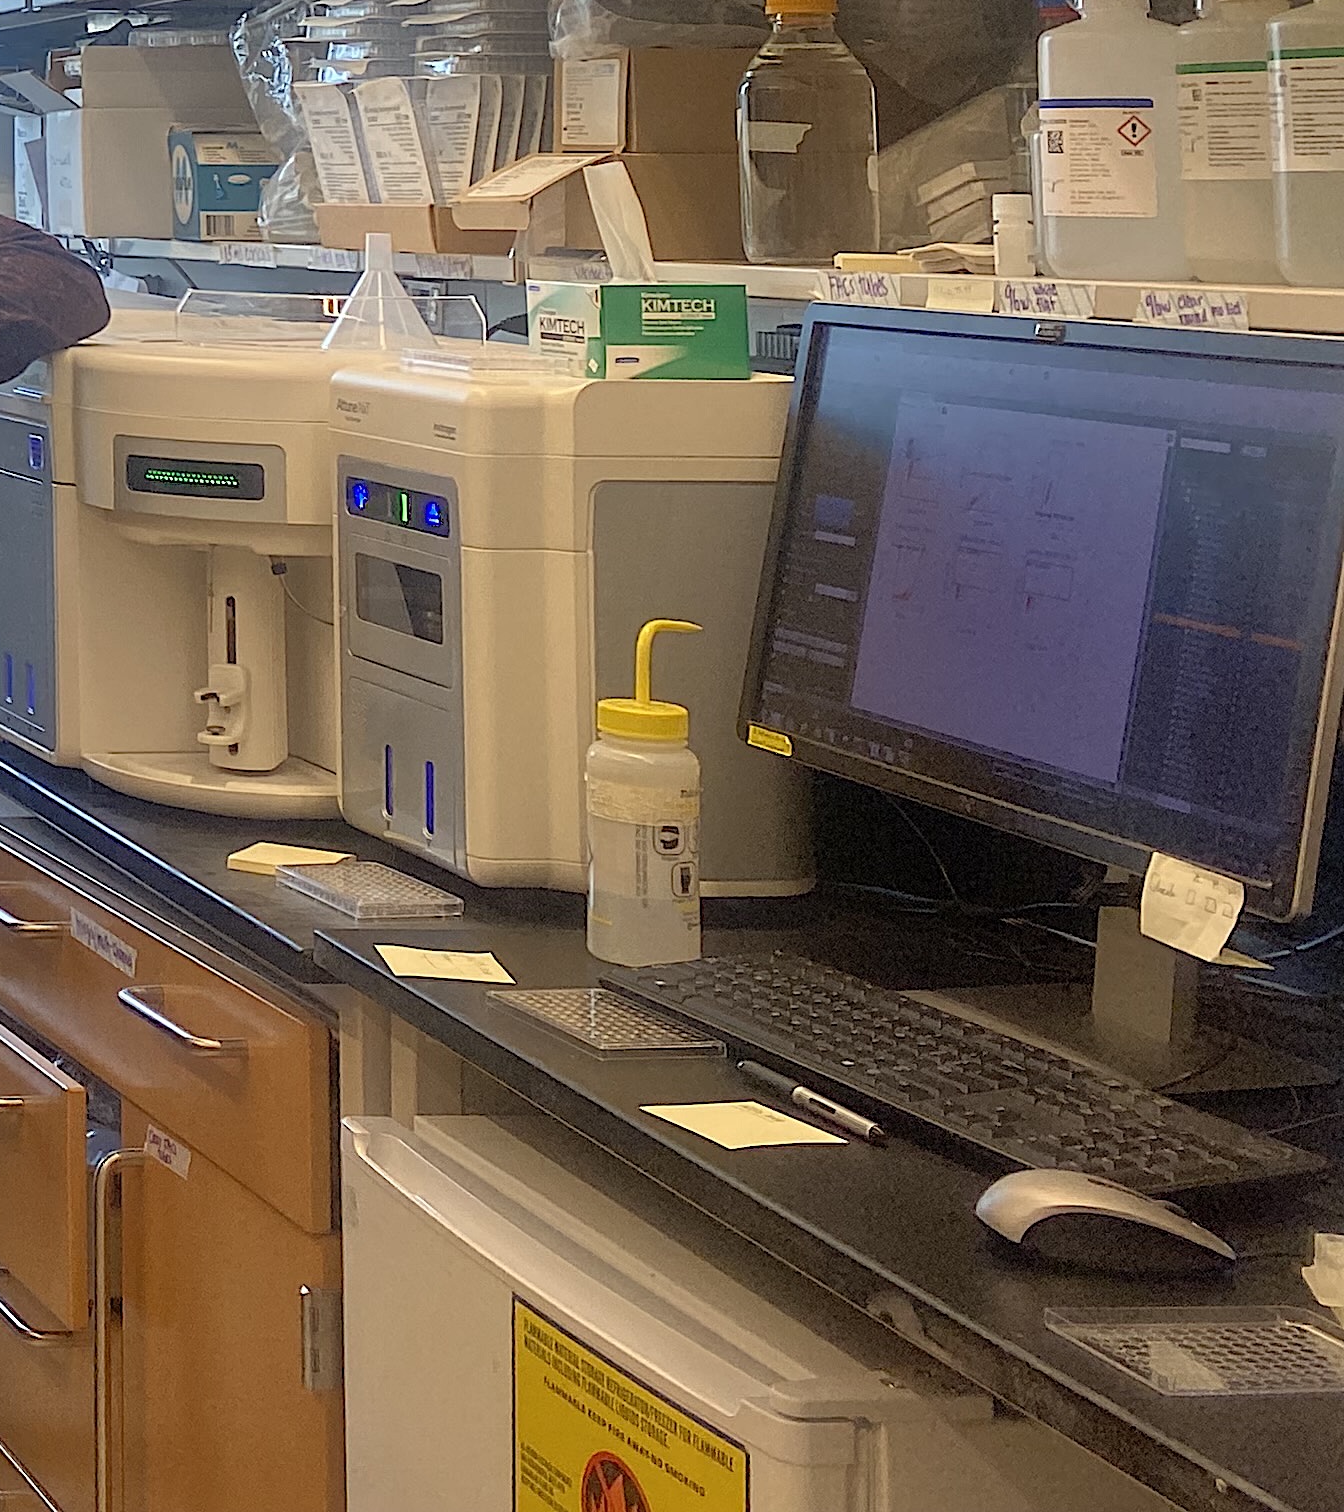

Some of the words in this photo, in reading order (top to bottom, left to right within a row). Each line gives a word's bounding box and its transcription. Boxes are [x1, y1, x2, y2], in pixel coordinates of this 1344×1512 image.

[641, 299, 715, 313] KIMTECH
[539, 316, 585, 335] KIMTECH
[587, 1406, 607, 1428] KEEP
[664, 1462, 706, 1497] SMOKING
